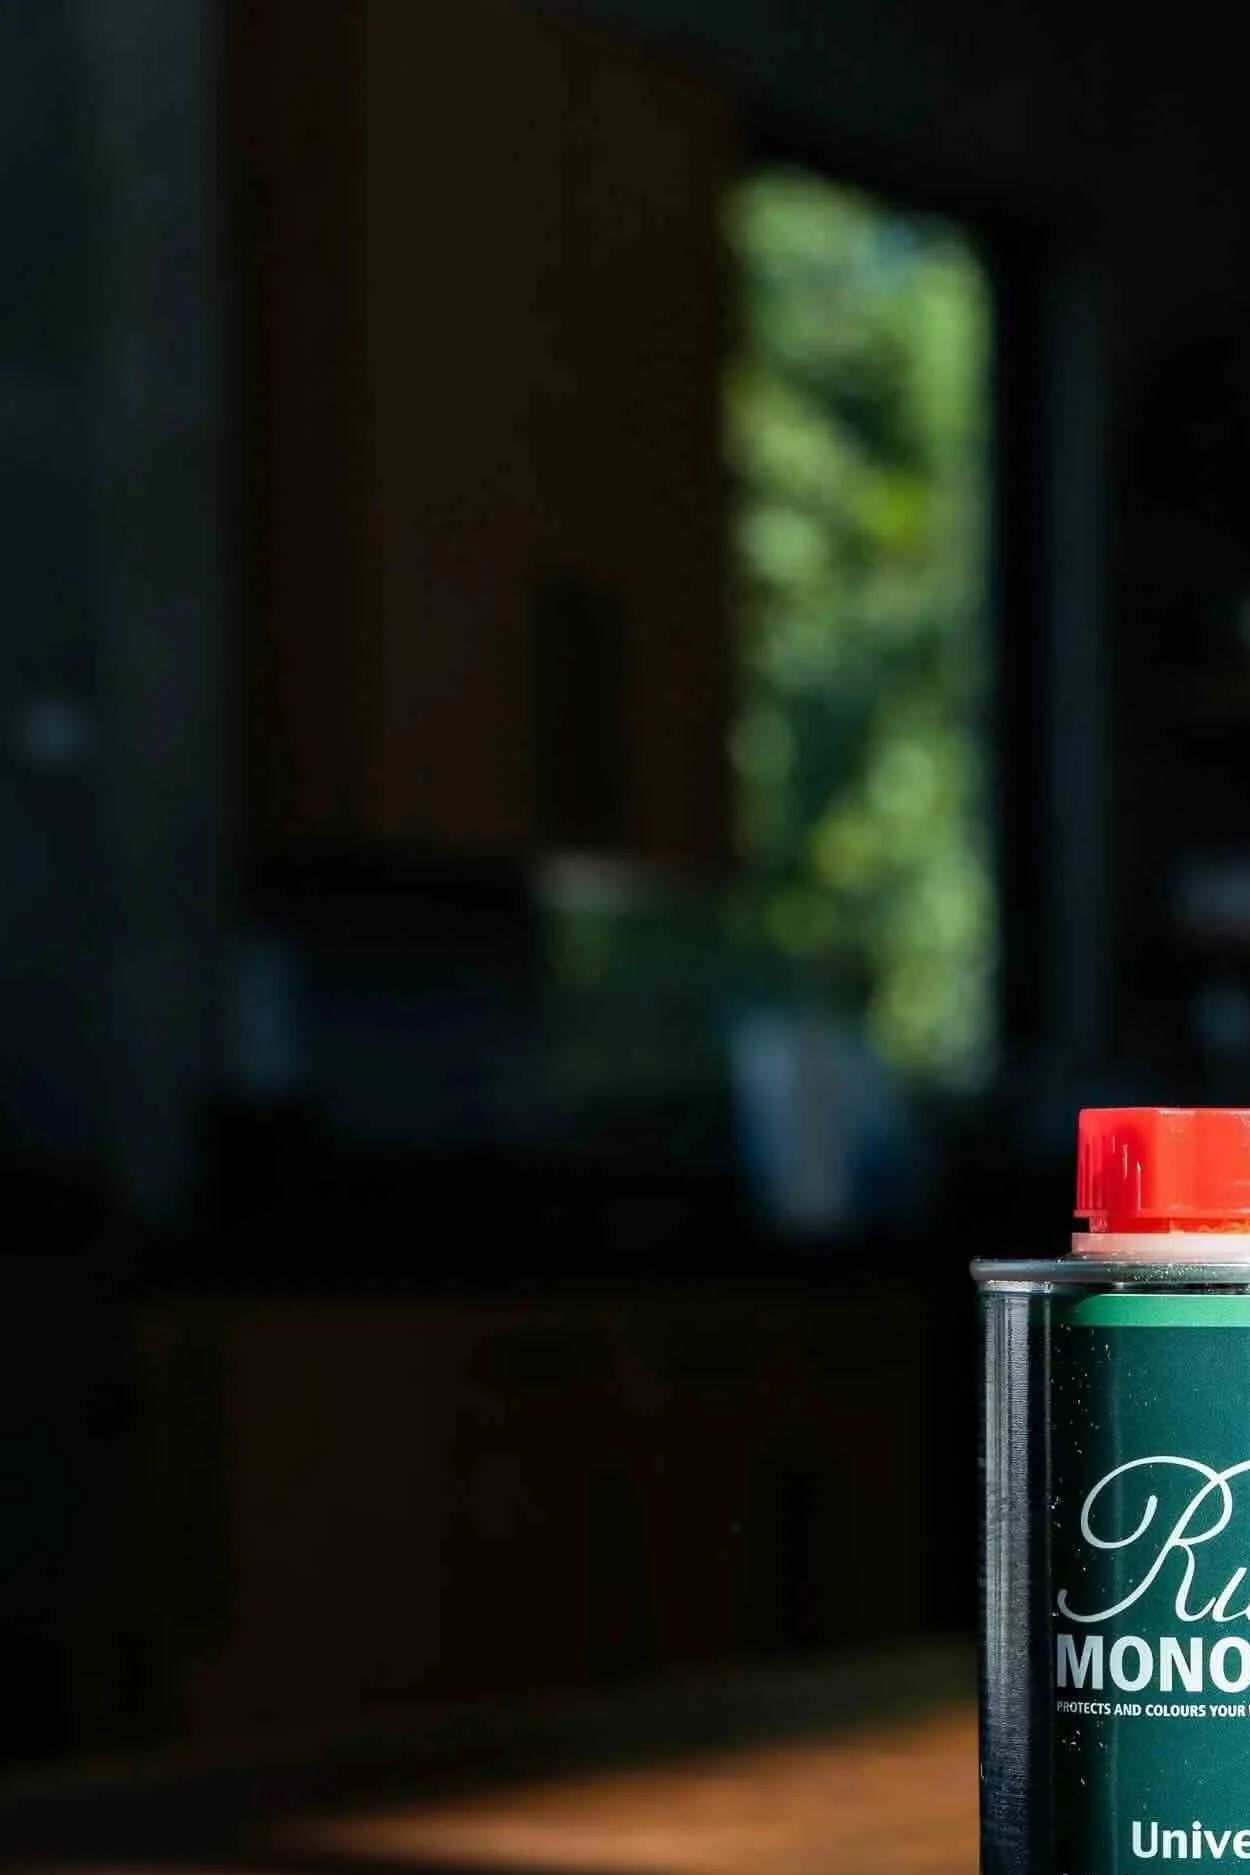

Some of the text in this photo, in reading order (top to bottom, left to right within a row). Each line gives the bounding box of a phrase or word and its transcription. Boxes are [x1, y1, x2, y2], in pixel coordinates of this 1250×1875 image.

[1057, 1701, 1111, 1715] PROTECTS
[1114, 1703, 1142, 1717] AND
[1145, 1704, 1206, 1718] COLOURS
[1210, 1705, 1246, 1717] YOUR
